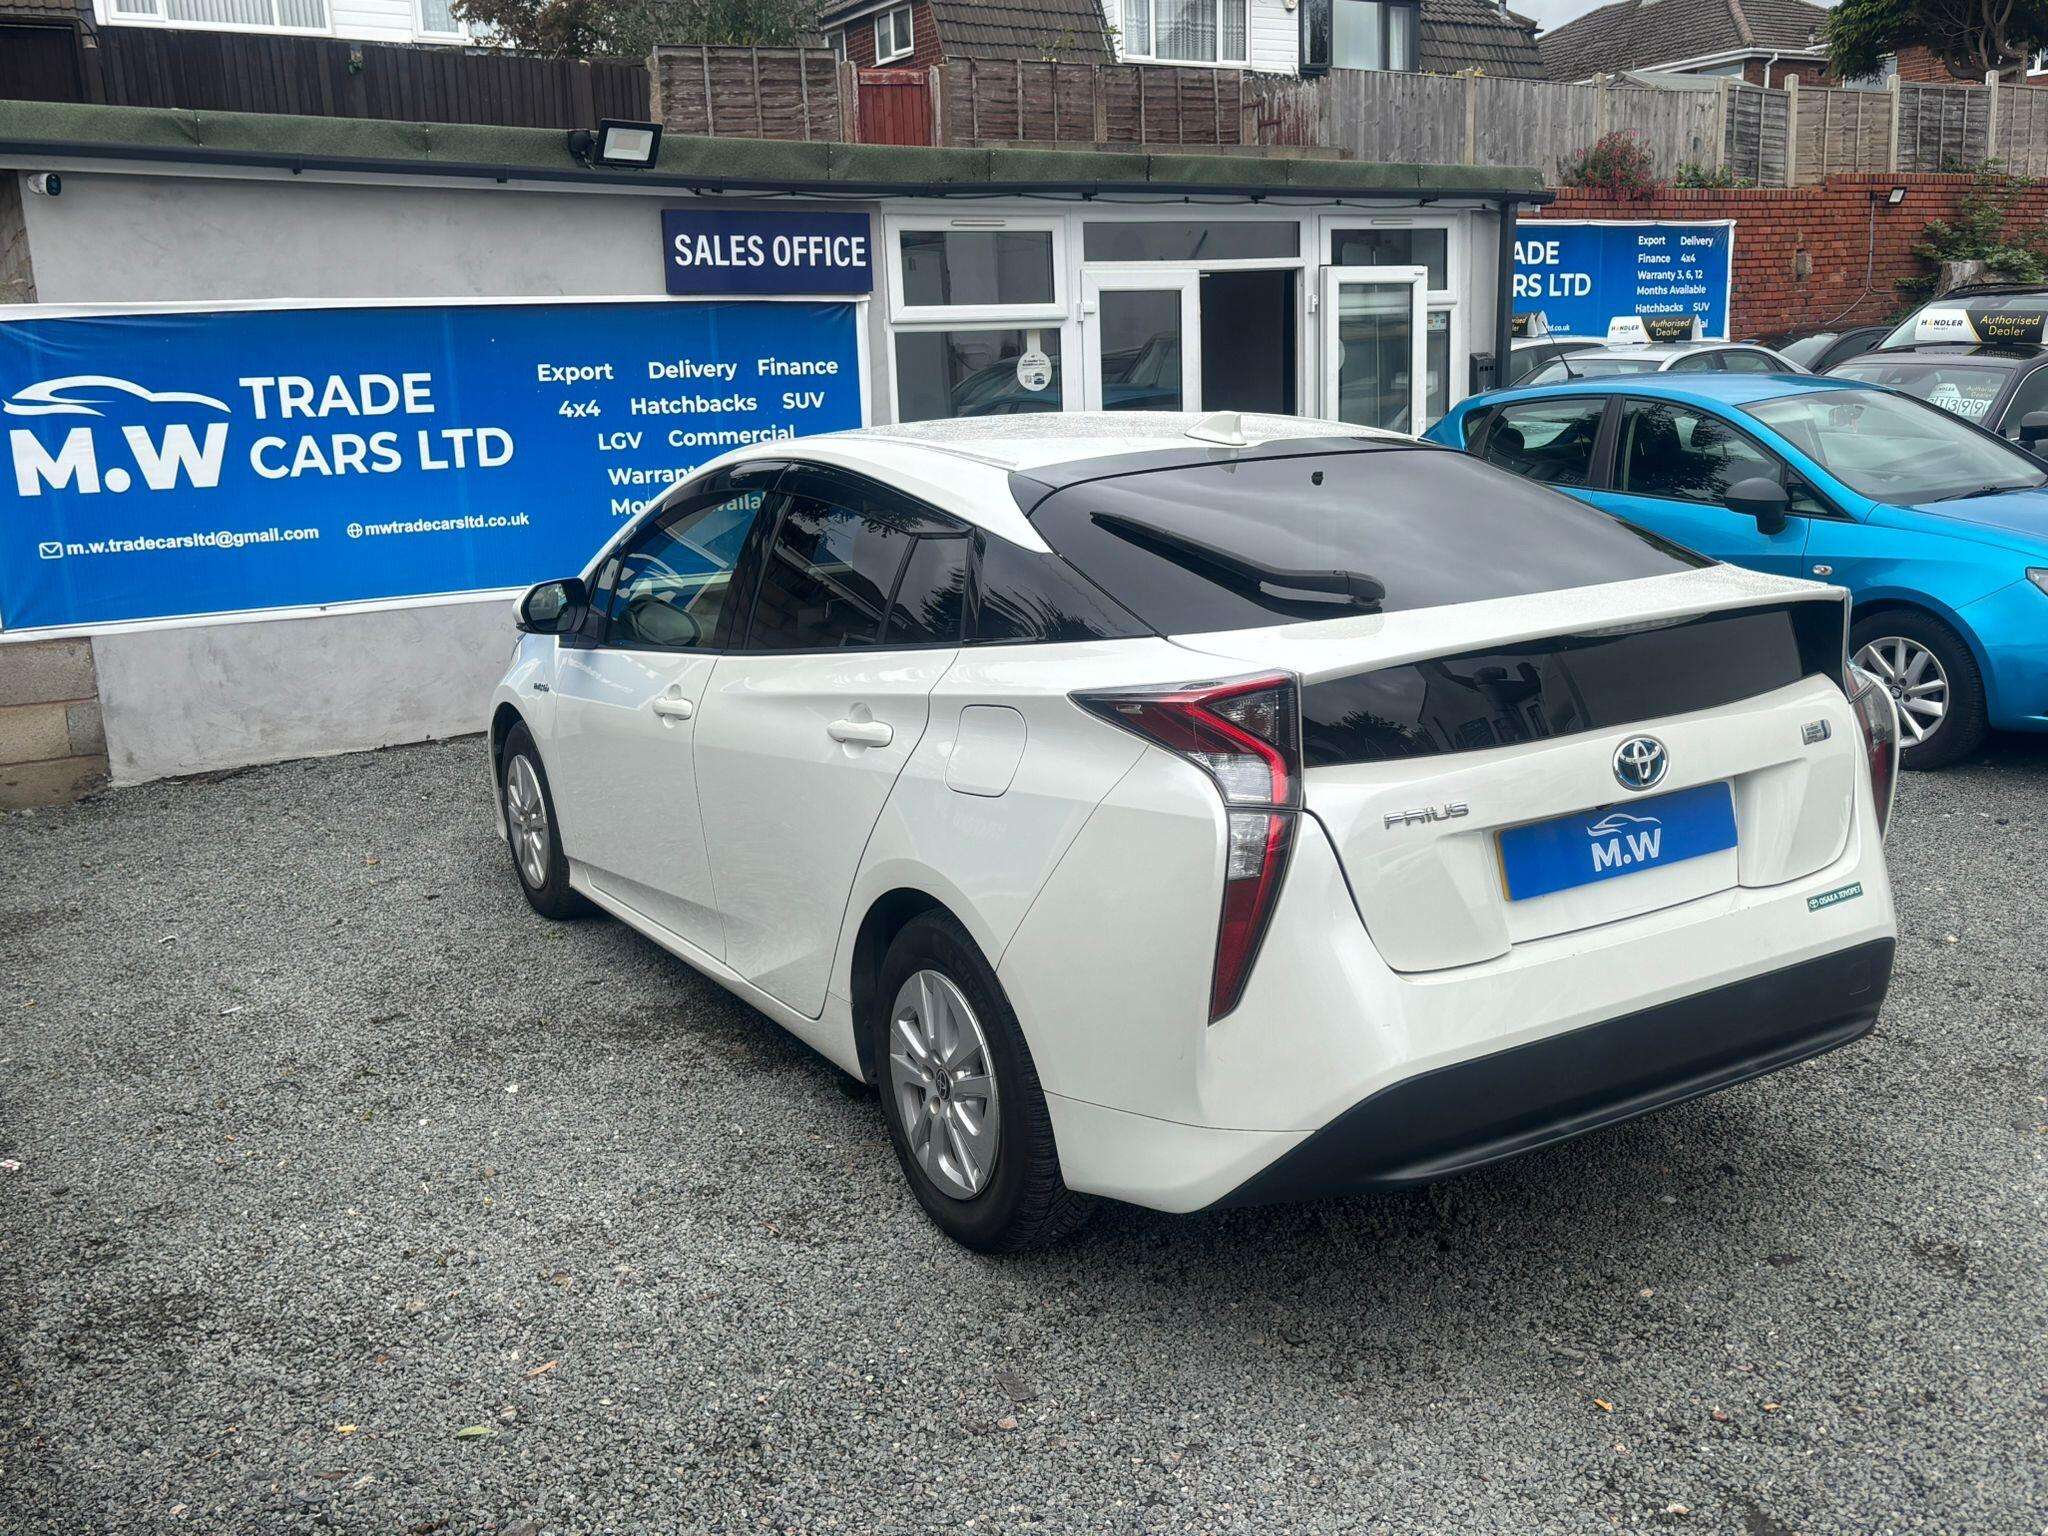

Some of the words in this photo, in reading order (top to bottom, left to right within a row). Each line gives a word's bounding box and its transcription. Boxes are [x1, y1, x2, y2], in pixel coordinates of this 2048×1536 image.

[674, 233, 765, 267] SALES
[772, 235, 867, 267] OFFICE
[1514, 240, 1560, 265] ADE
[1638, 236, 1666, 247] Export
[1680, 236, 1714, 247] Delivery
[1638, 253, 1671, 263] Finance
[1680, 253, 1696, 263] 4x4
[1512, 273, 1542, 298] RS
[1549, 272, 1592, 297] LTD
[1637, 270, 1676, 281] Warranty
[1677, 270, 1685, 280] 3,
[1685, 270, 1693, 280] 6,
[1694, 269, 1703, 279] 12
[1636, 285, 1668, 296] Months
[1669, 284, 1707, 295] Available
[1635, 302, 1684, 314] Hatchbacks
[1692, 302, 1711, 311] SUV
[1981, 314, 2041, 326] Authorised
[1988, 325, 2026, 337] Dealer
[537, 363, 615, 385] Export
[648, 360, 738, 382] Delivery
[758, 356, 839, 376] Finance
[239, 372, 436, 420] TRADE
[558, 400, 602, 418] 4x4
[631, 394, 758, 416] Hatchbacks
[782, 391, 825, 410] SUV
[597, 431, 643, 451] LGV
[668, 424, 796, 447] Commercial
[9, 422, 229, 497] M.W
[250, 431, 402, 479] CARS
[418, 427, 514, 470] LTD
[607, 465, 696, 486] Warran
[364, 512, 530, 536] mwtradecarsltd.co.uk
[66, 526, 320, 556] m.w.tradecarsltd@gmail.com
[1384, 802, 1470, 830] PRIUS
[1591, 828, 1662, 873] M.W
